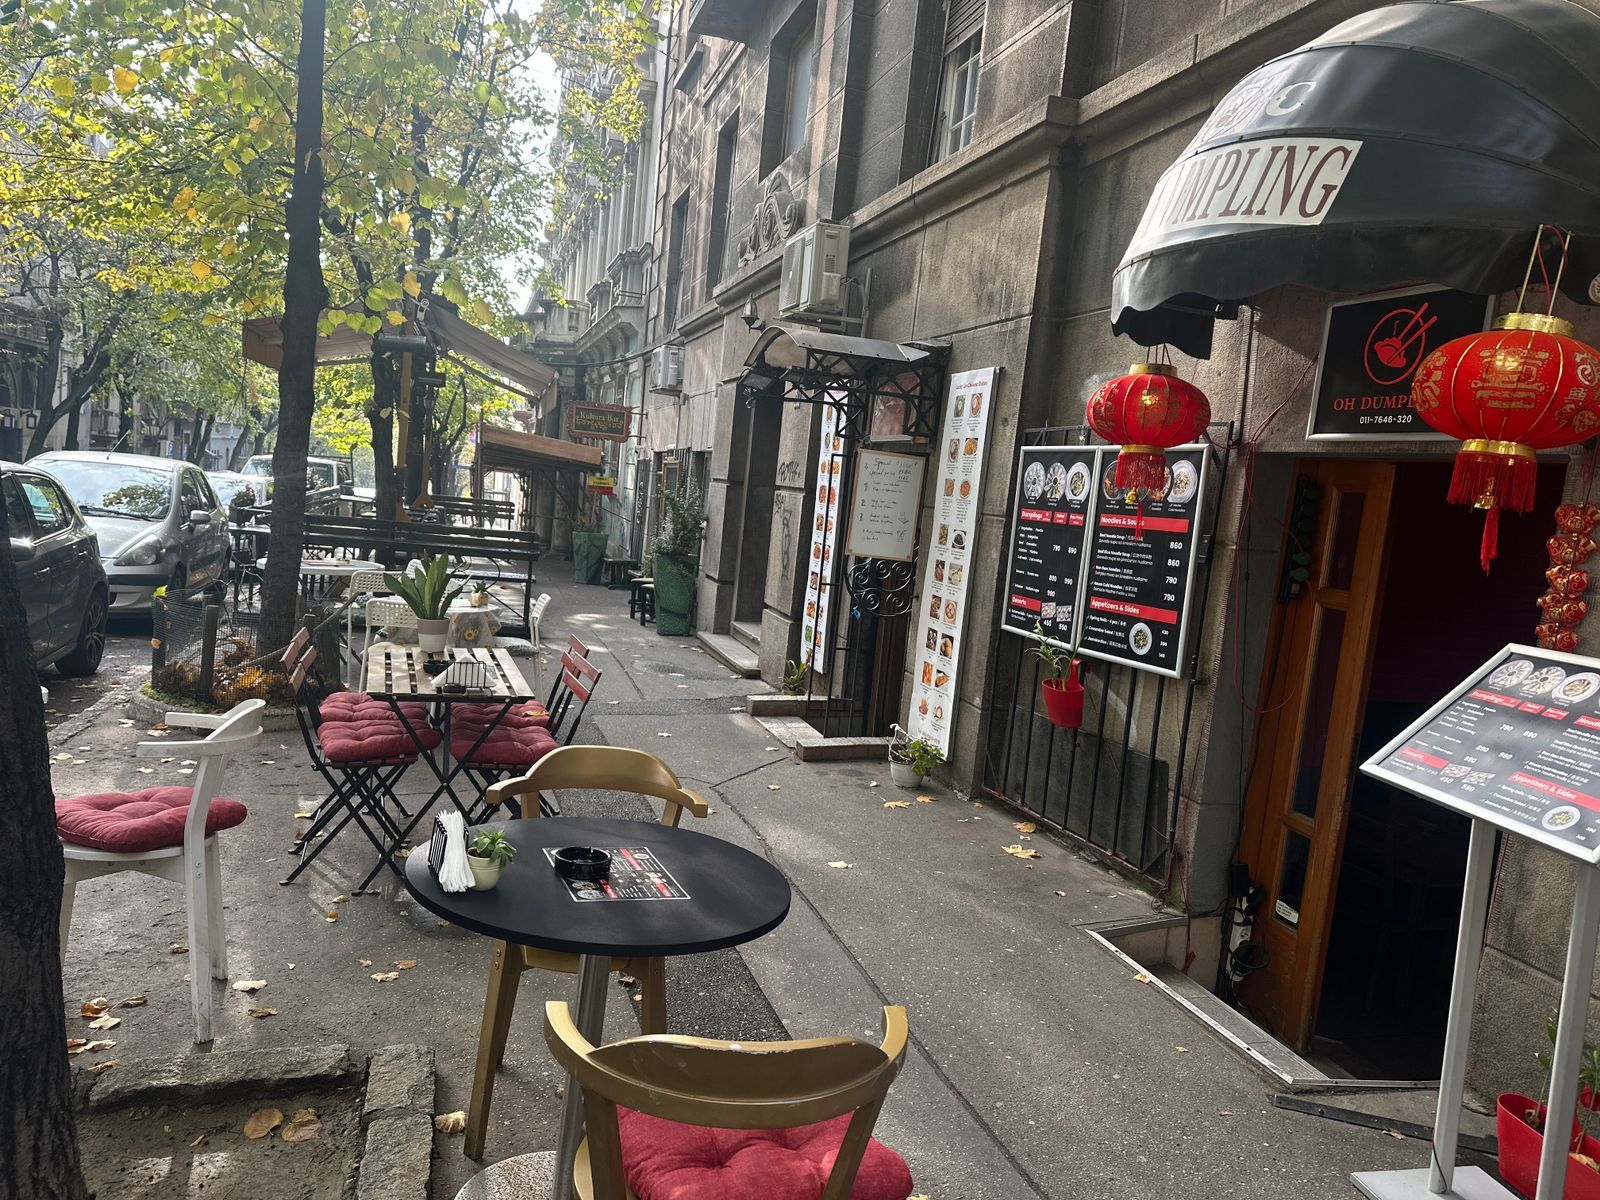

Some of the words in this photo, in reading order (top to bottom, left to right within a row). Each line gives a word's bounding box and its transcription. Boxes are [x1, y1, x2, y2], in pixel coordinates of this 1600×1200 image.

[1334, 396, 1356, 411] OH
[1359, 414, 1412, 424] 011-7646-320
[1021, 510, 1042, 520] Dumplings
[1101, 516, 1121, 524] Noodles
[1169, 541, 1182, 549] 860
[1167, 559, 1180, 567] 860
[1165, 576, 1177, 584] 790
[1163, 593, 1174, 601] 790
[1091, 599, 1118, 611] Appetizers
[1124, 605, 1139, 614] Sides
[1469, 691, 1504, 703] Dumplings
[1511, 773, 1550, 790] Appetizers
[1555, 787, 1577, 799] Sides
